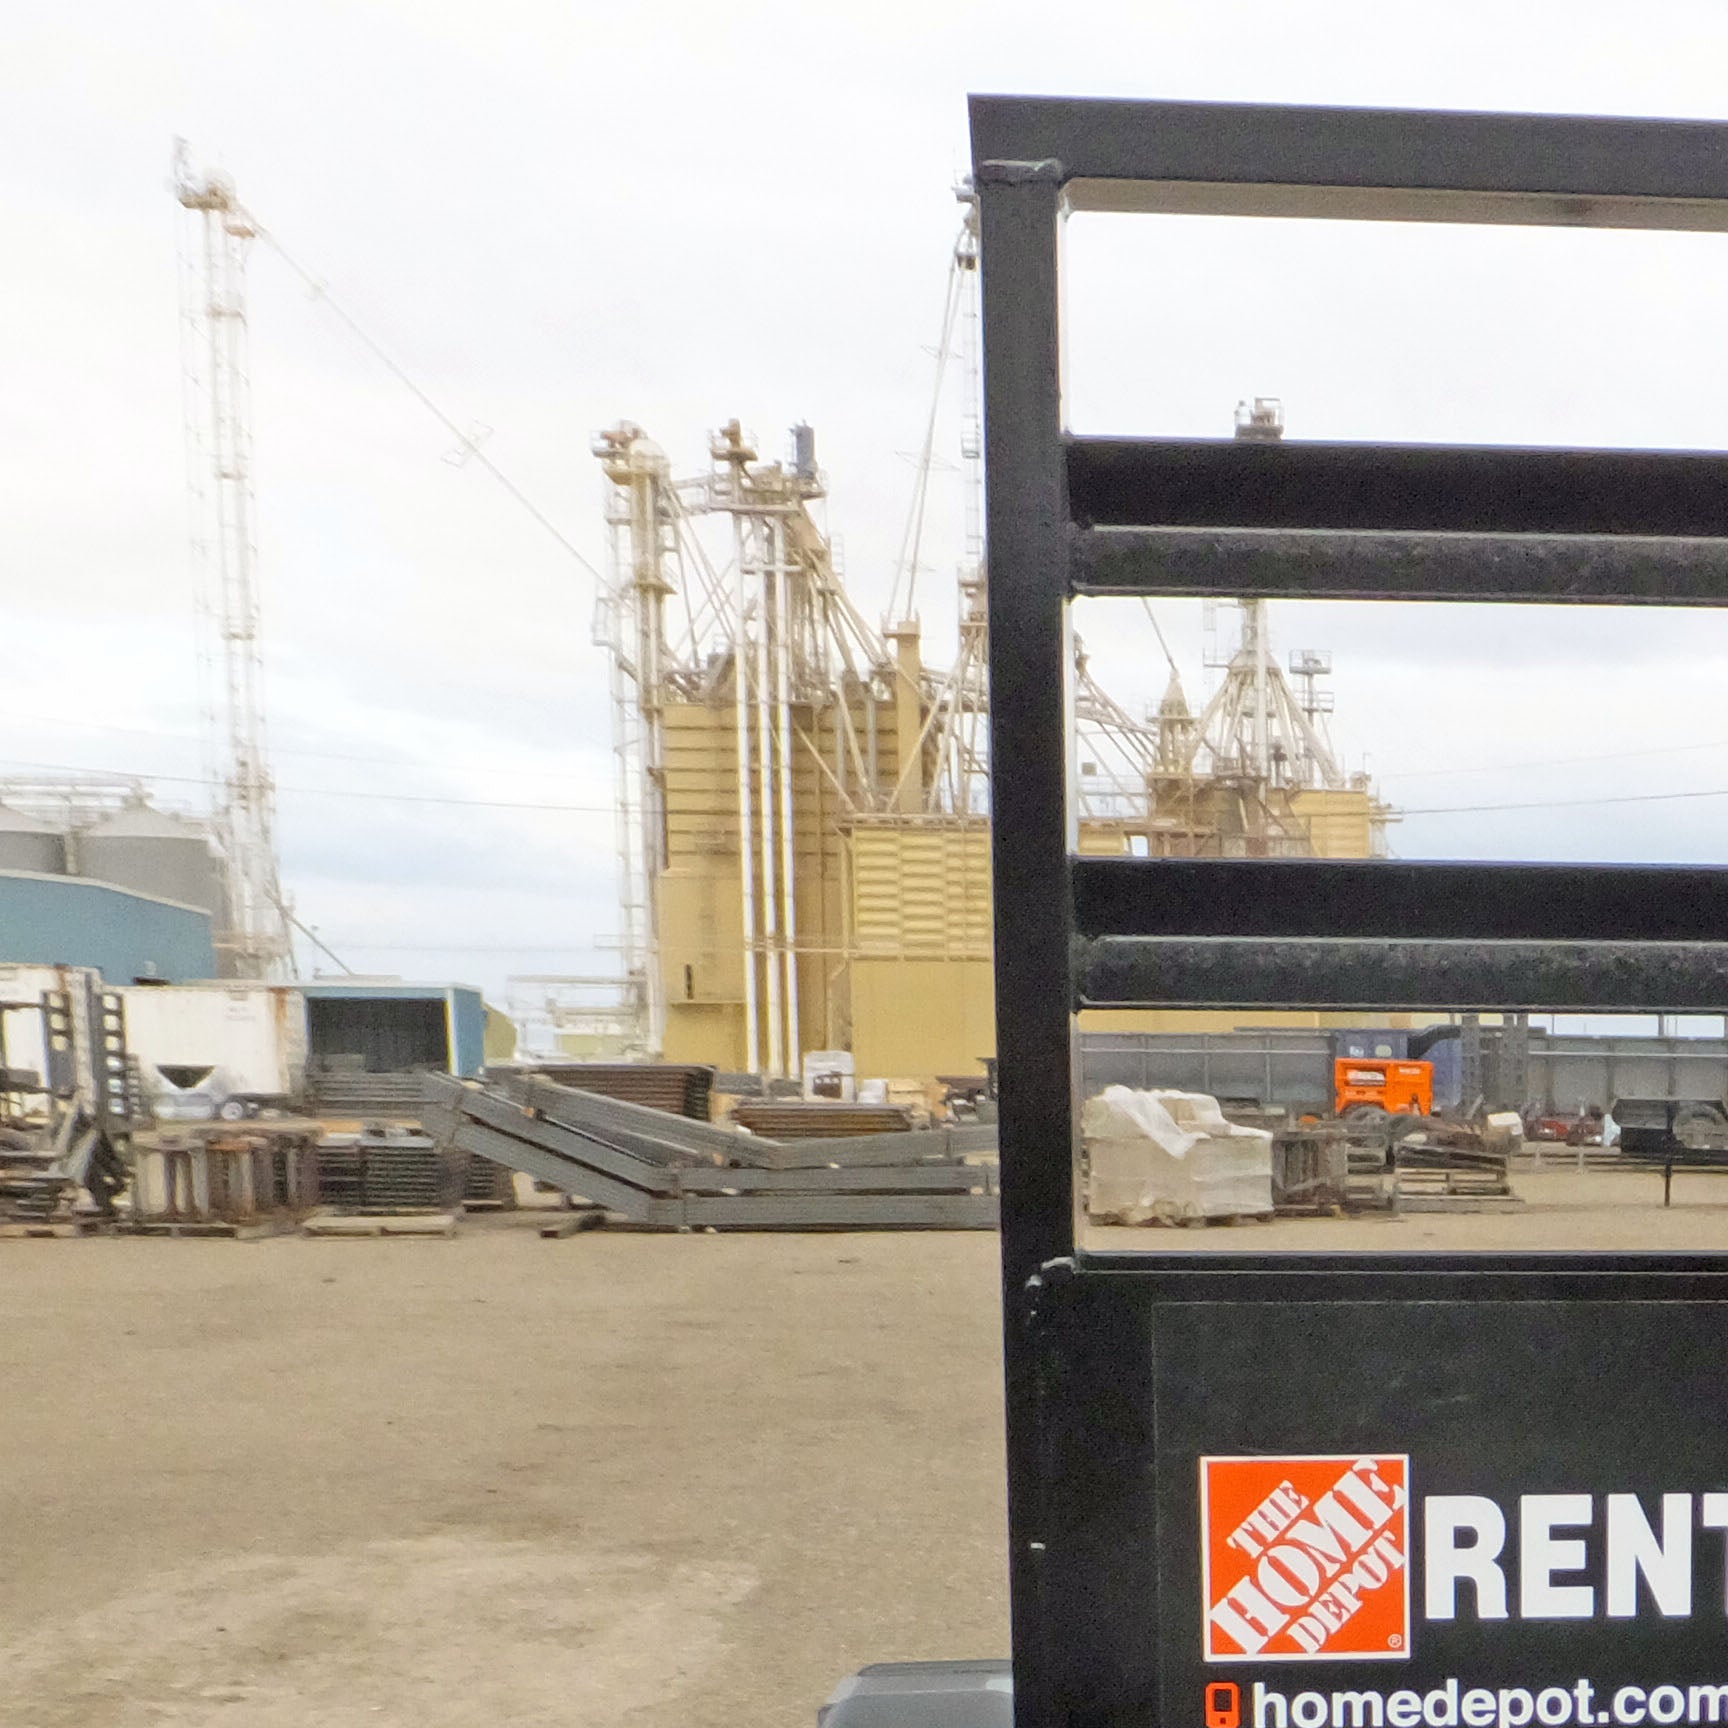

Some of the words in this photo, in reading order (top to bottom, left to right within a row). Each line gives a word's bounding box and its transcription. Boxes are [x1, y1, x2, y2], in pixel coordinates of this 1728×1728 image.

[1209, 1457, 1405, 1654] HOME
[1226, 1480, 1309, 1559] THE
[1286, 1530, 1405, 1654] DEPOT
